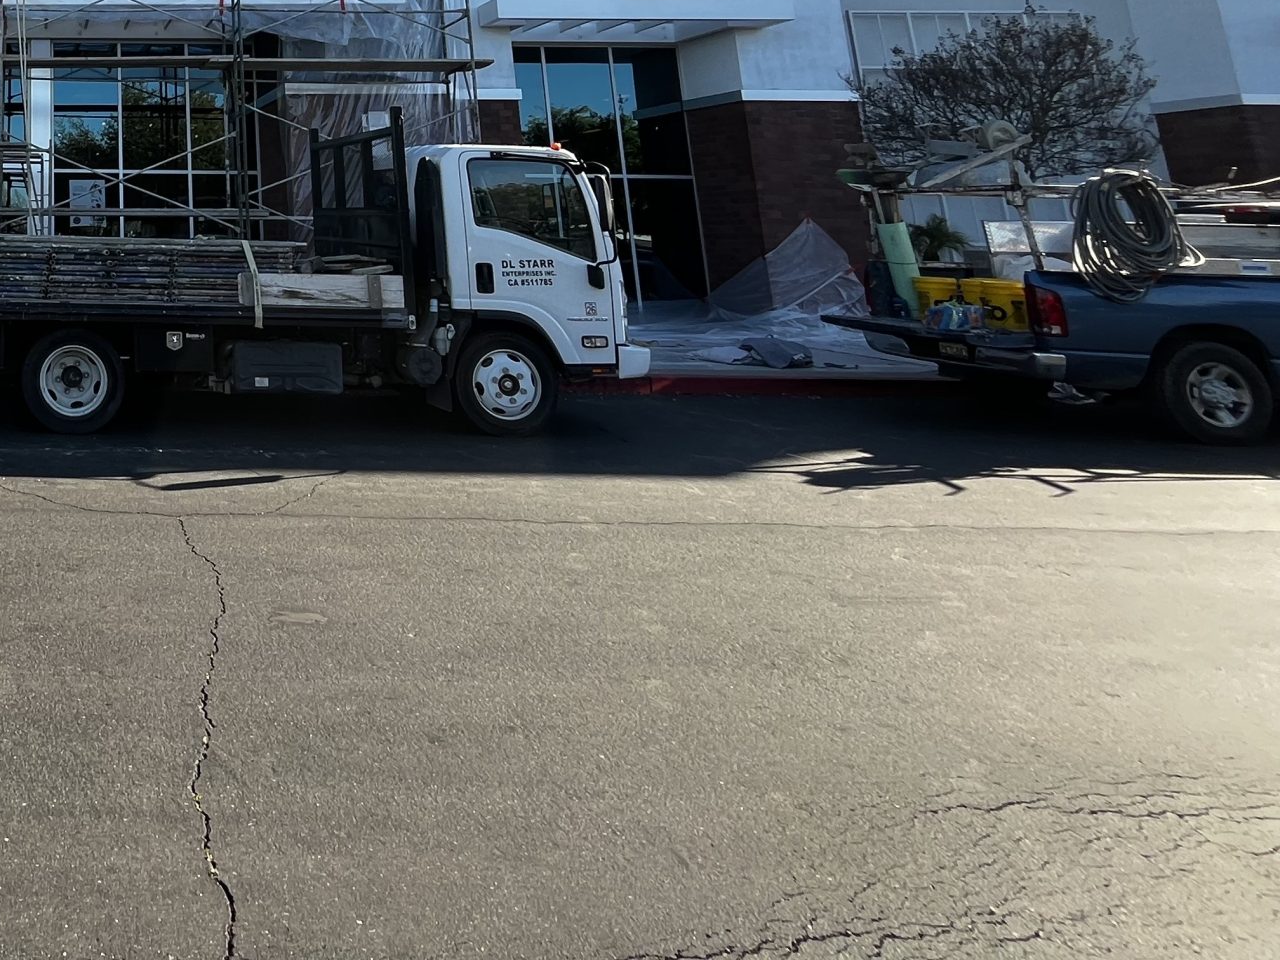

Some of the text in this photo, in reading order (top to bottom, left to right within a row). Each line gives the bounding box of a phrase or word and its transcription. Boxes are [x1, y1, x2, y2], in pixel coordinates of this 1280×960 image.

[501, 259, 555, 269] DL STARR
[507, 279, 519, 287] CA
